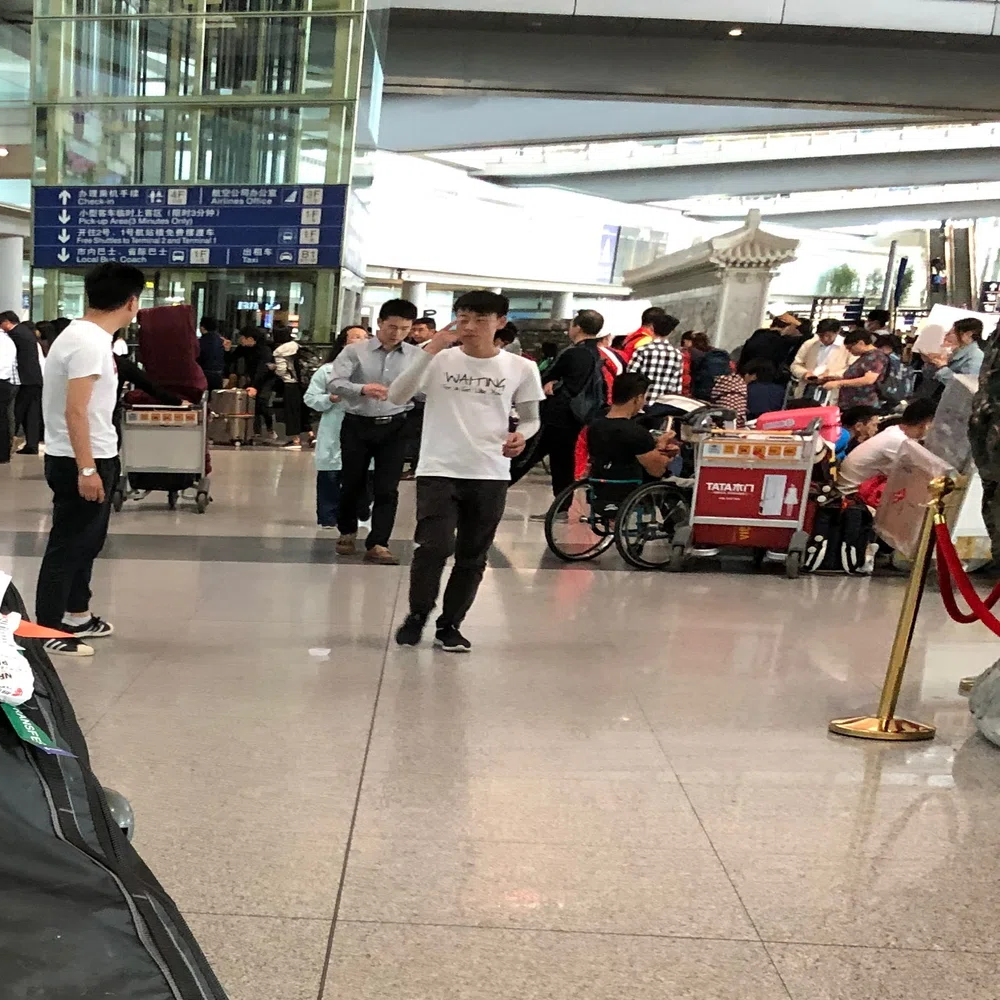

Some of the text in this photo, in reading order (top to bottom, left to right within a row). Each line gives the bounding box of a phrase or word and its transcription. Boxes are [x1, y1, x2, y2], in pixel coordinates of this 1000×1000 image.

[211, 189, 277, 198] 航空公司办公室
[78, 218, 109, 226] Pick-up
[172, 218, 193, 226] Only)
[242, 248, 272, 256] 出租车
